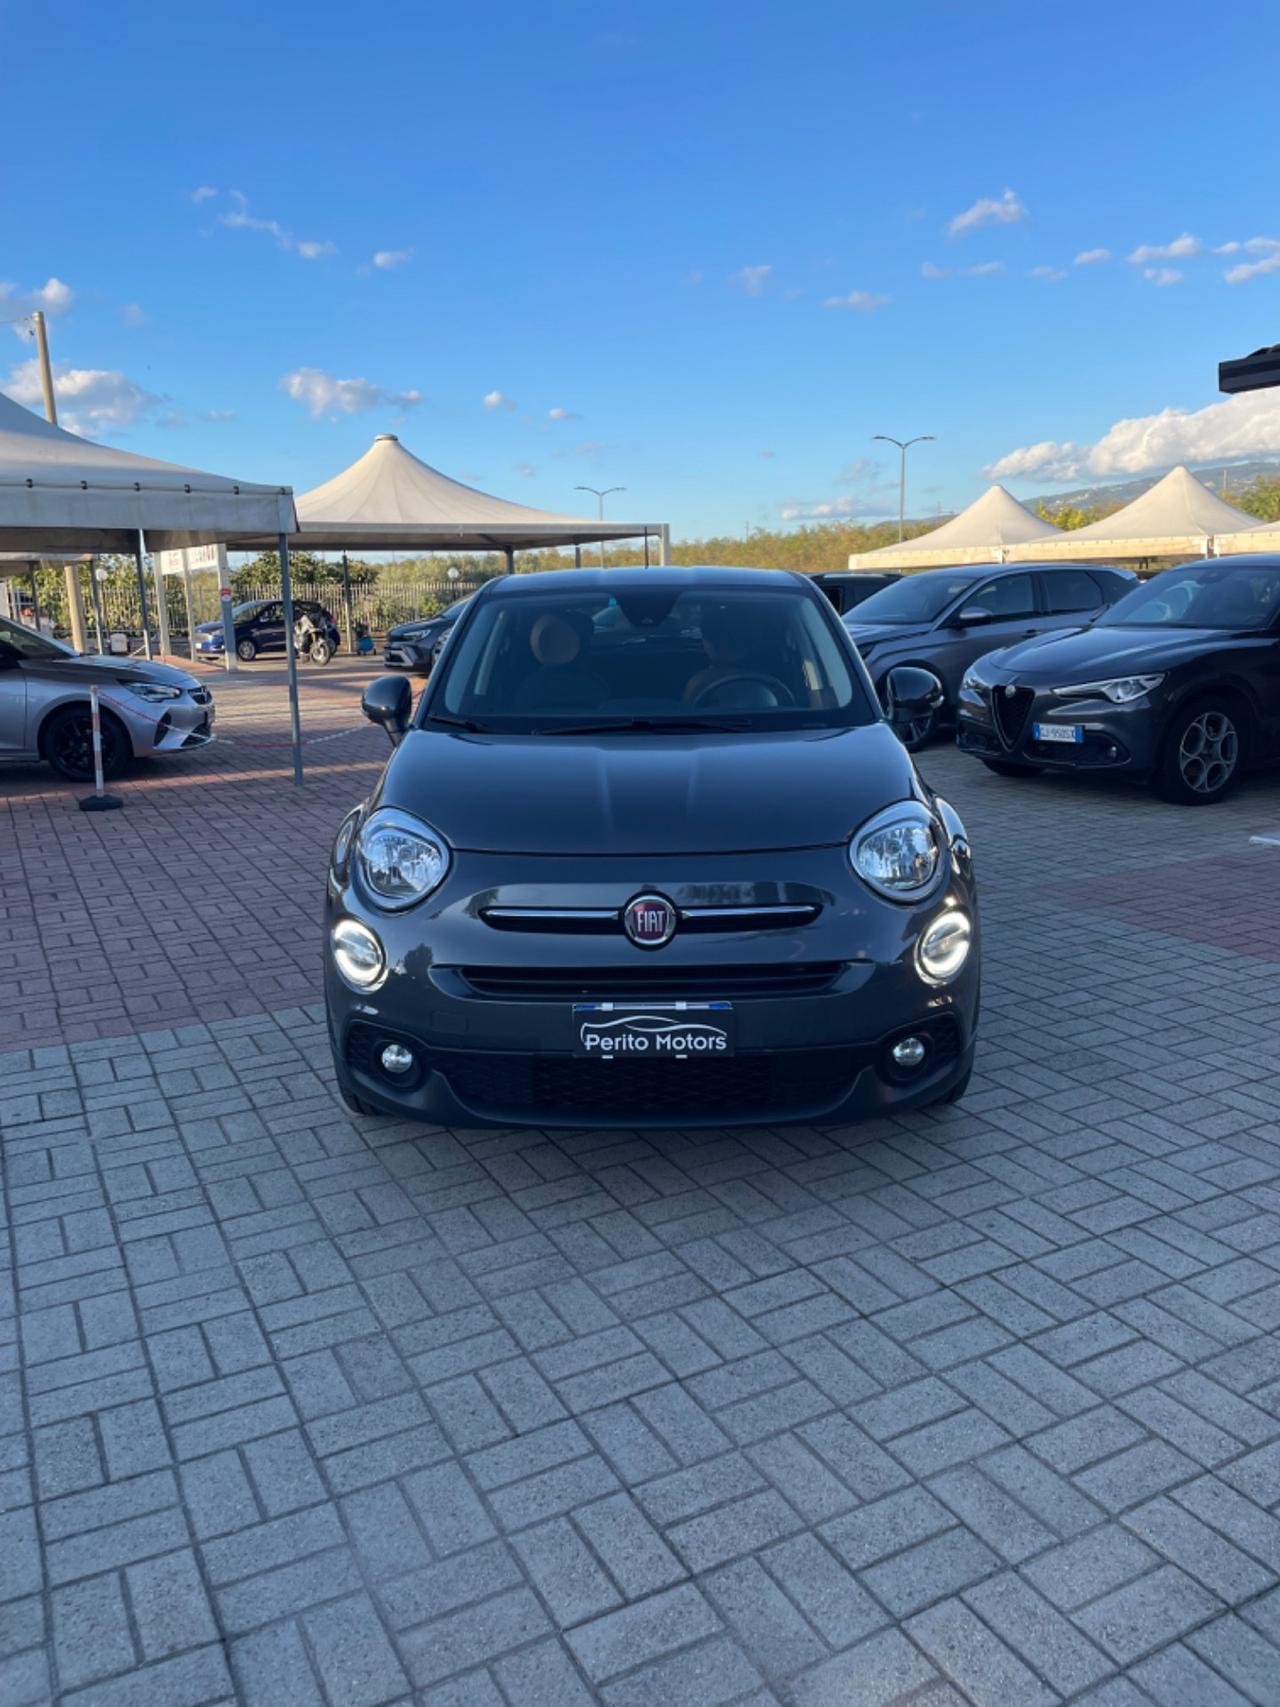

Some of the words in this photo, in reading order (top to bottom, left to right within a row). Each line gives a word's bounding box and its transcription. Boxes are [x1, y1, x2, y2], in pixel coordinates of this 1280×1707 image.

[637, 910, 665, 932] FIAT
[584, 1033, 649, 1051] Perito
[656, 1033, 727, 1050] Motors
